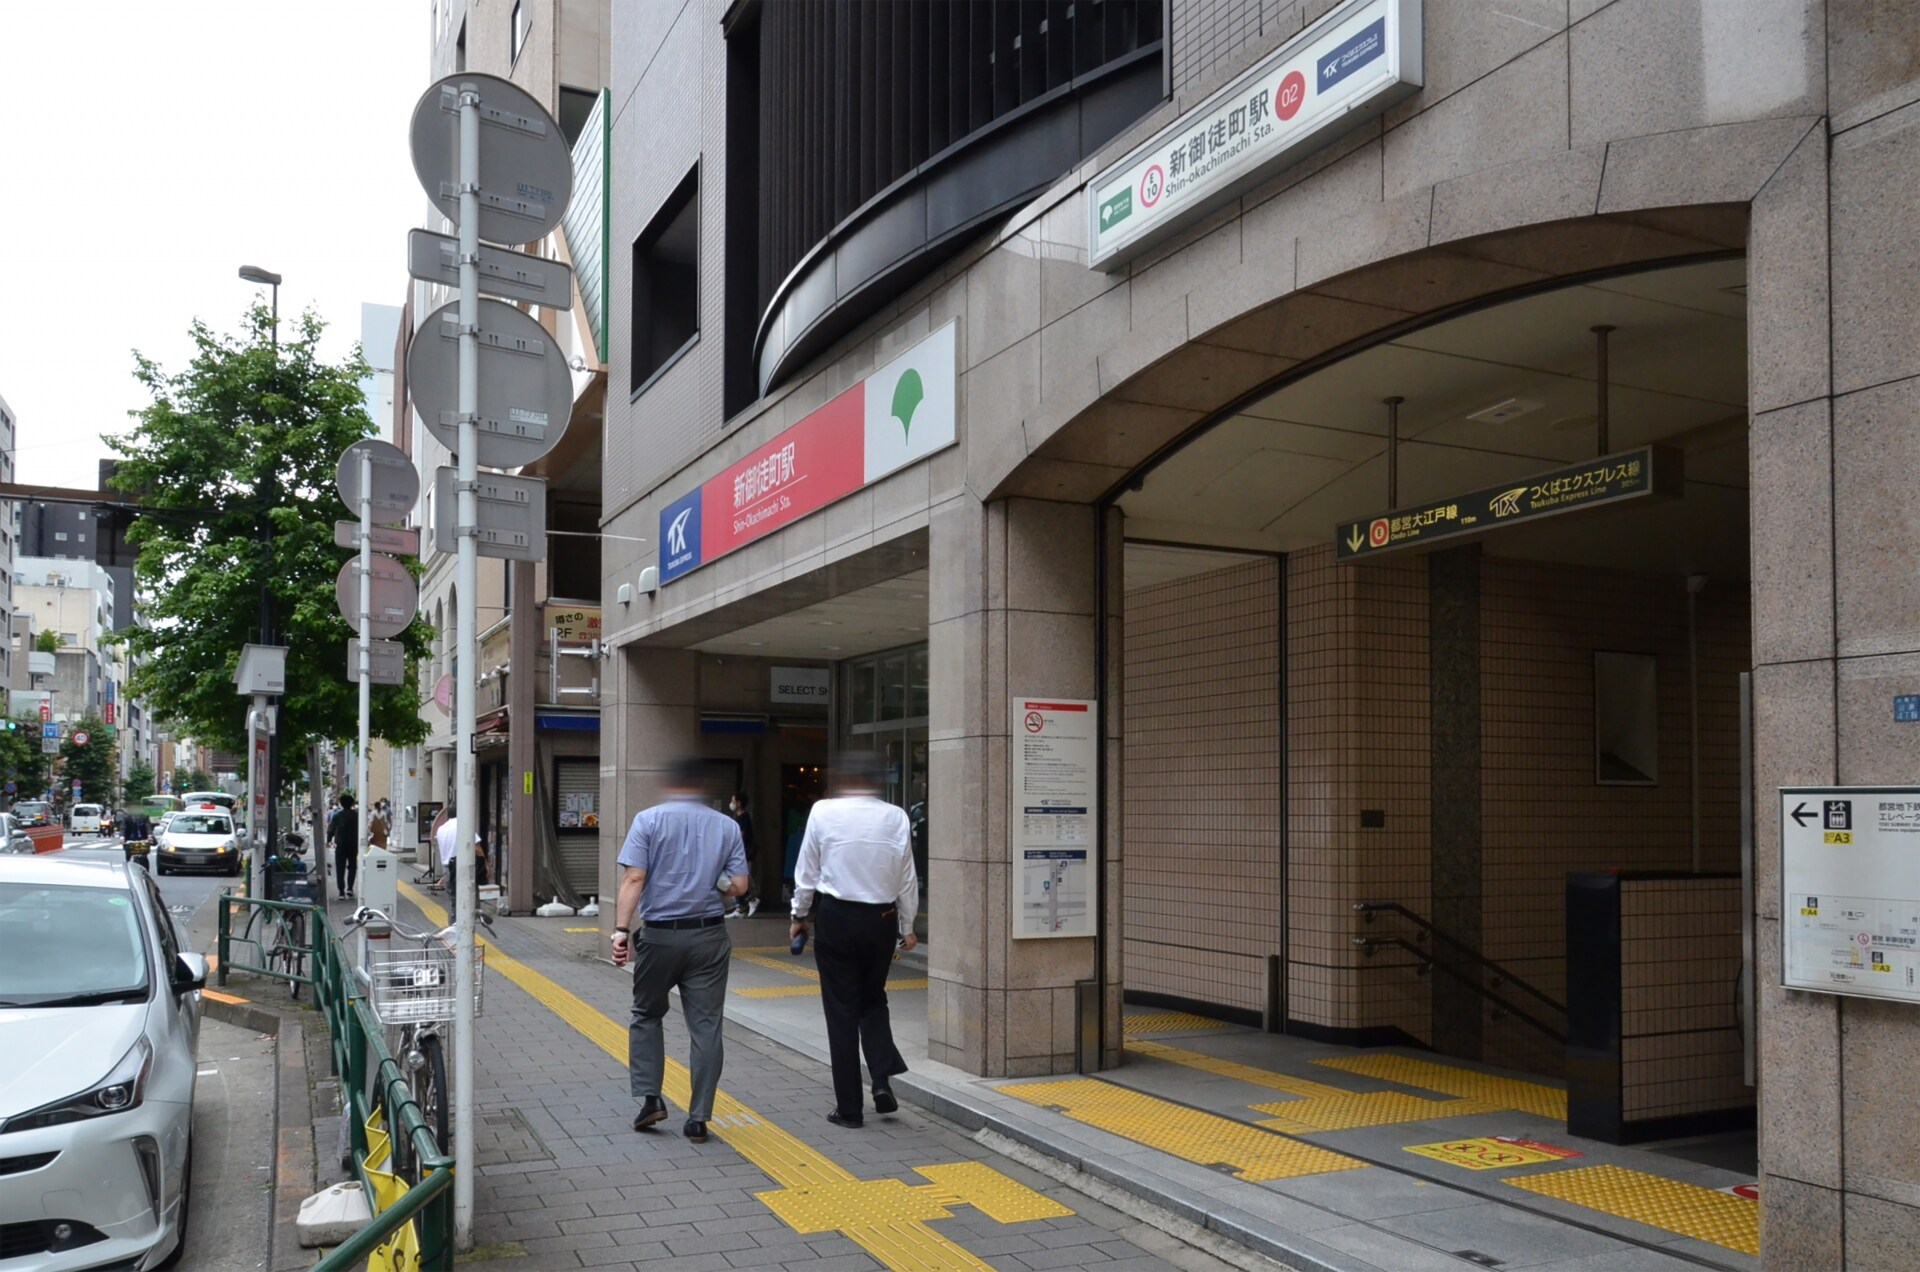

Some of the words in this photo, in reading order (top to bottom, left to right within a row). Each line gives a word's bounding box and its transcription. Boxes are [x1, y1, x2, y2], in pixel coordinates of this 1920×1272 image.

[1281, 84, 1299, 109] 02
[1169, 88, 1269, 179] 新御徒町駅
[1165, 132, 1251, 199] Shin-okachimachi
[1253, 123, 1274, 142] Sta.
[1149, 173, 1154, 184] E
[1147, 183, 1158, 199] 10
[733, 441, 795, 509] 新御徒町駅
[1530, 460, 1641, 499] つくばエクスプレス線
[1530, 496, 1559, 509] Tsukuba
[1561, 489, 1589, 502] Express
[1590, 485, 1607, 495] Line
[1390, 504, 1458, 532] 都営大江戸線
[1407, 529, 1420, 537] Line
[778, 684, 816, 695] SELECT
[76, 734, 85, 742] 40
[1834, 832, 1850, 844] A3
[1880, 964, 1891, 973] A3
